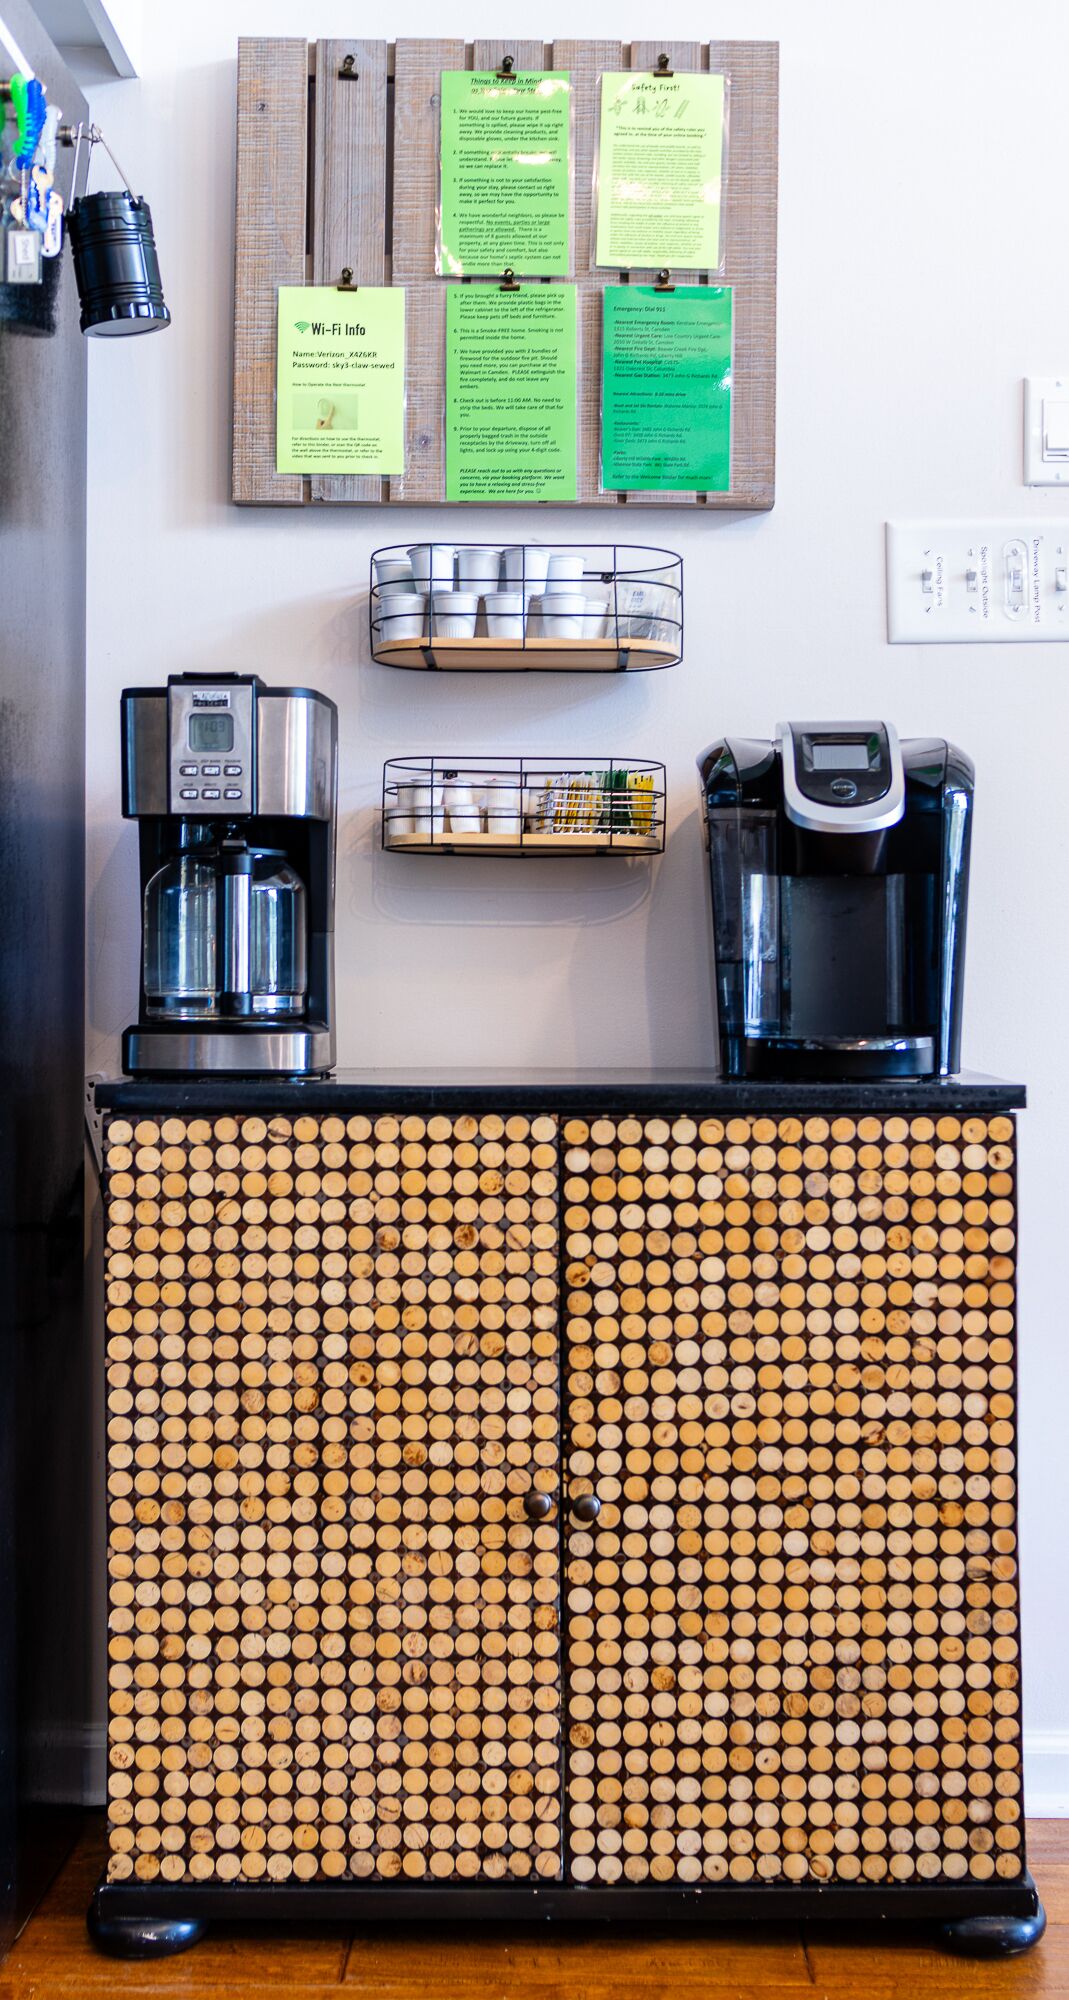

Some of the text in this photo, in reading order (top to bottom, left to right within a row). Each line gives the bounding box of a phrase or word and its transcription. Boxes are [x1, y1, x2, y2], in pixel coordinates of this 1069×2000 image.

[632, 83, 656, 94] Safety
[312, 323, 366, 336] Wi-Fi Info
